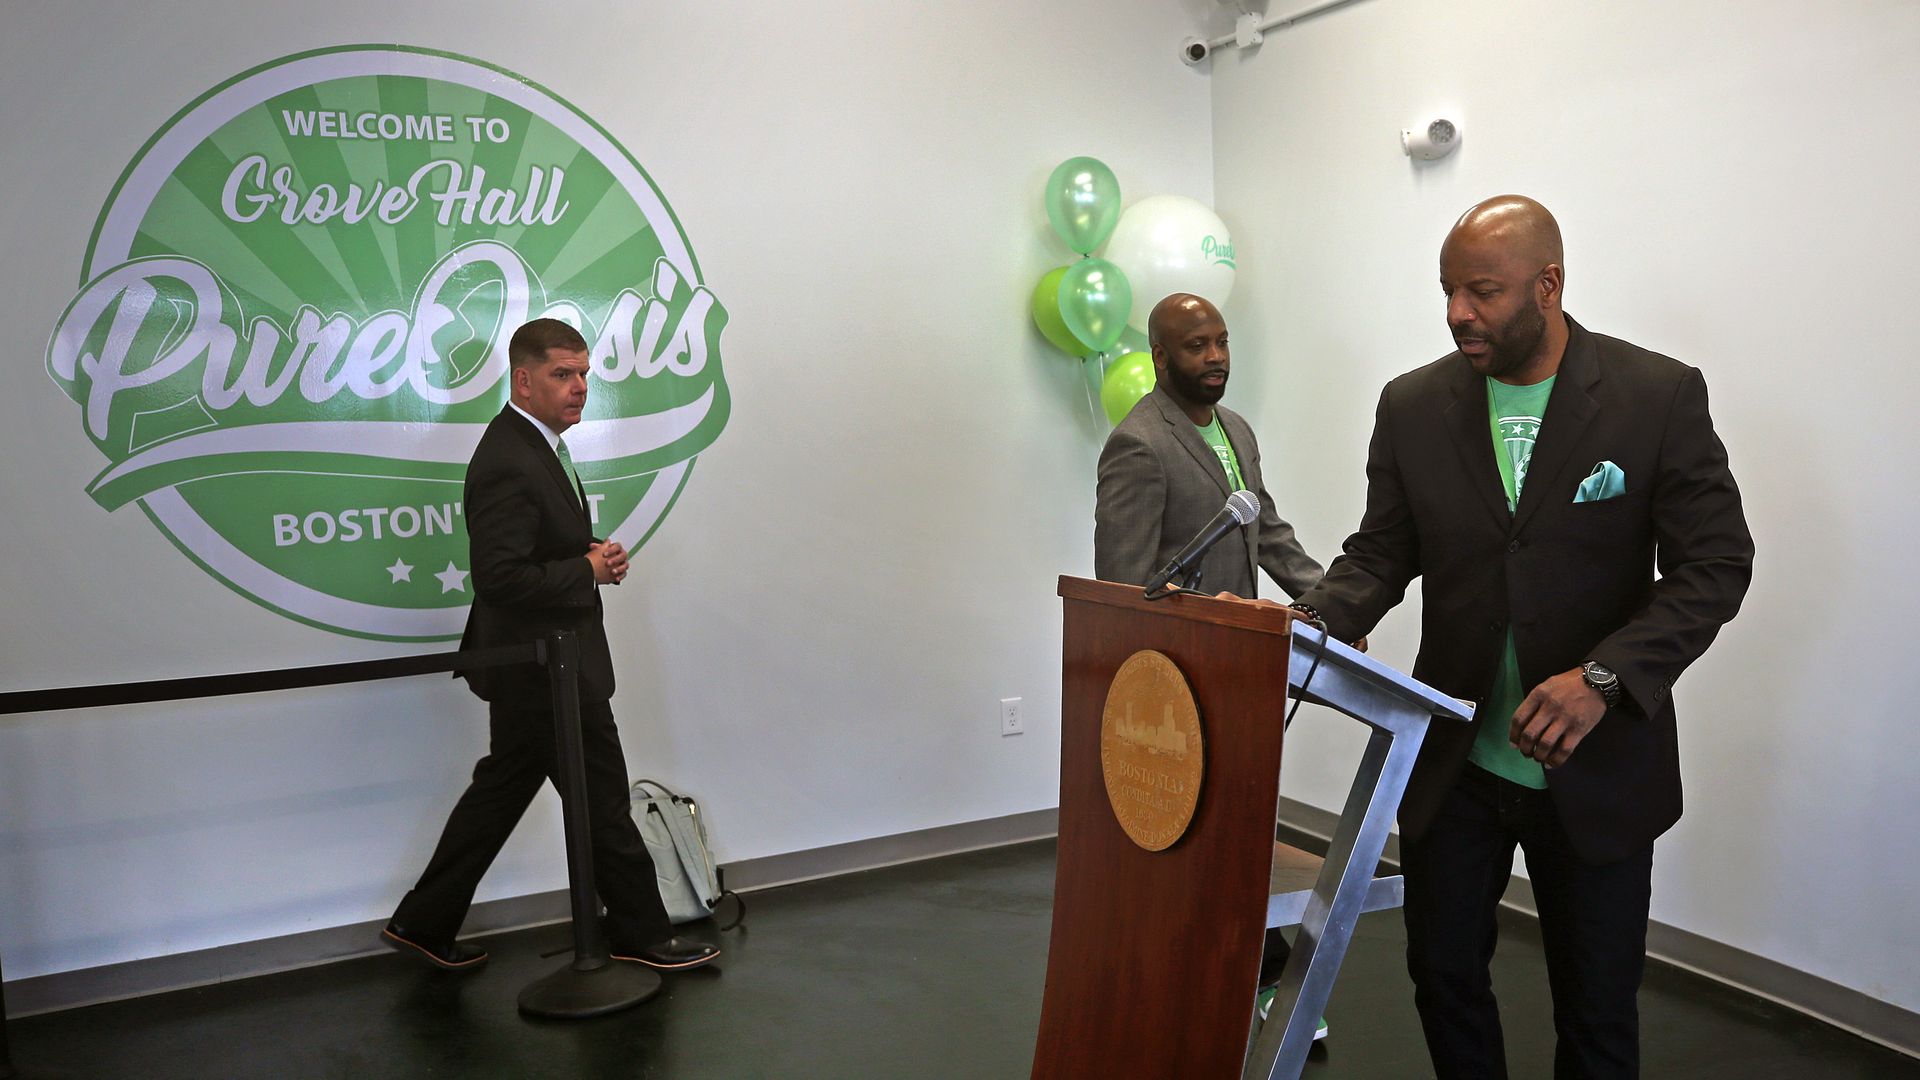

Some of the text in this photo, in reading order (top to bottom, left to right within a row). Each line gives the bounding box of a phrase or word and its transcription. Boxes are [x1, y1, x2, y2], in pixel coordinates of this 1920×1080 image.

[281, 109, 511, 143] WELCOME TO
[220, 154, 570, 226] Grove Hall
[50, 241, 715, 441] PureOsis
[272, 501, 463, 548] BOSTON'
